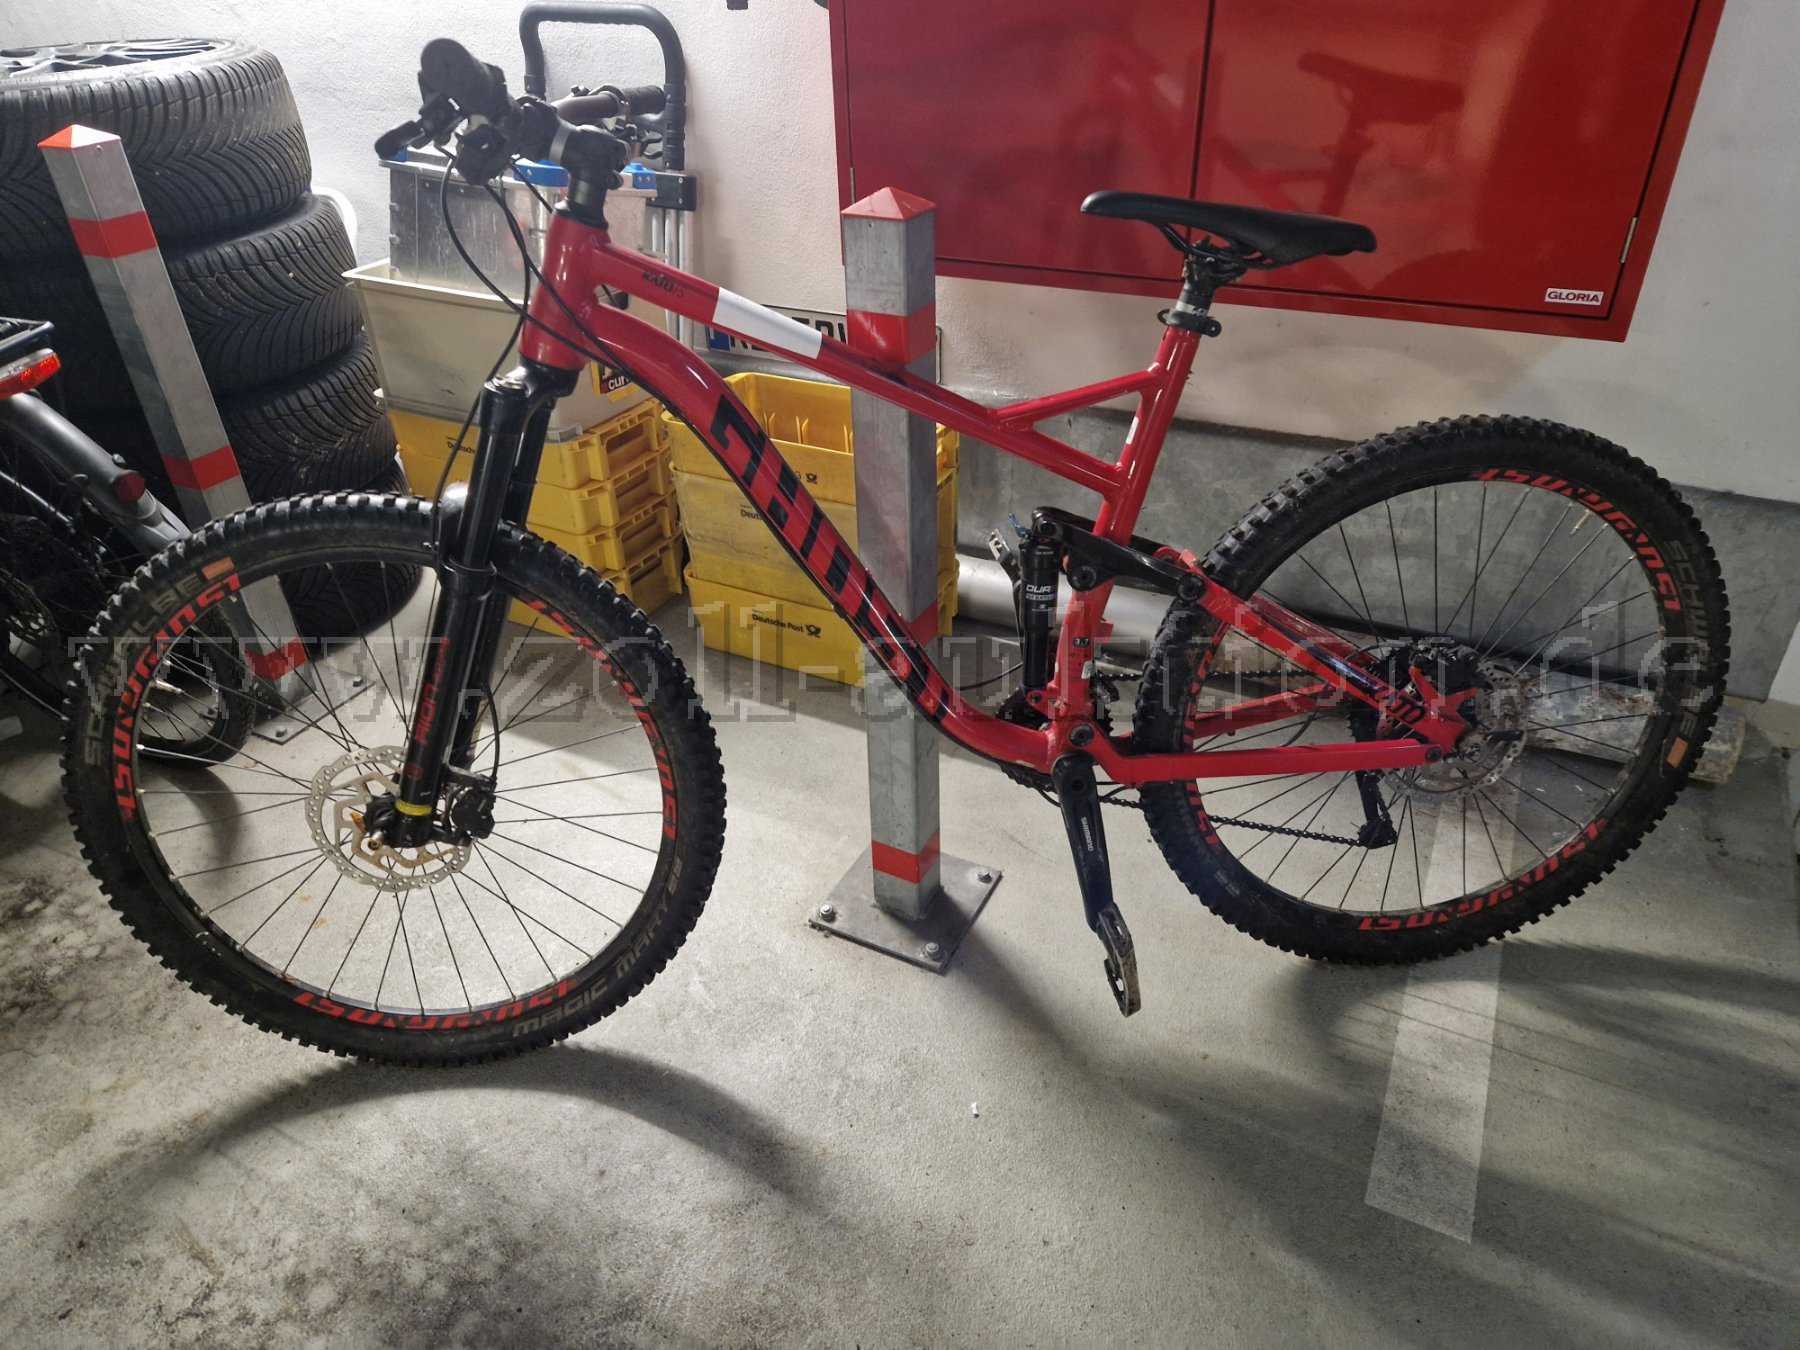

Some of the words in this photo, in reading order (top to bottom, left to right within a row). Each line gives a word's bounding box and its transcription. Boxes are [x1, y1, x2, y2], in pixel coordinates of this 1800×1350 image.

[1547, 291, 1600, 303] GLORIA
[752, 613, 787, 629] Deutsche
[787, 621, 804, 633] Post
